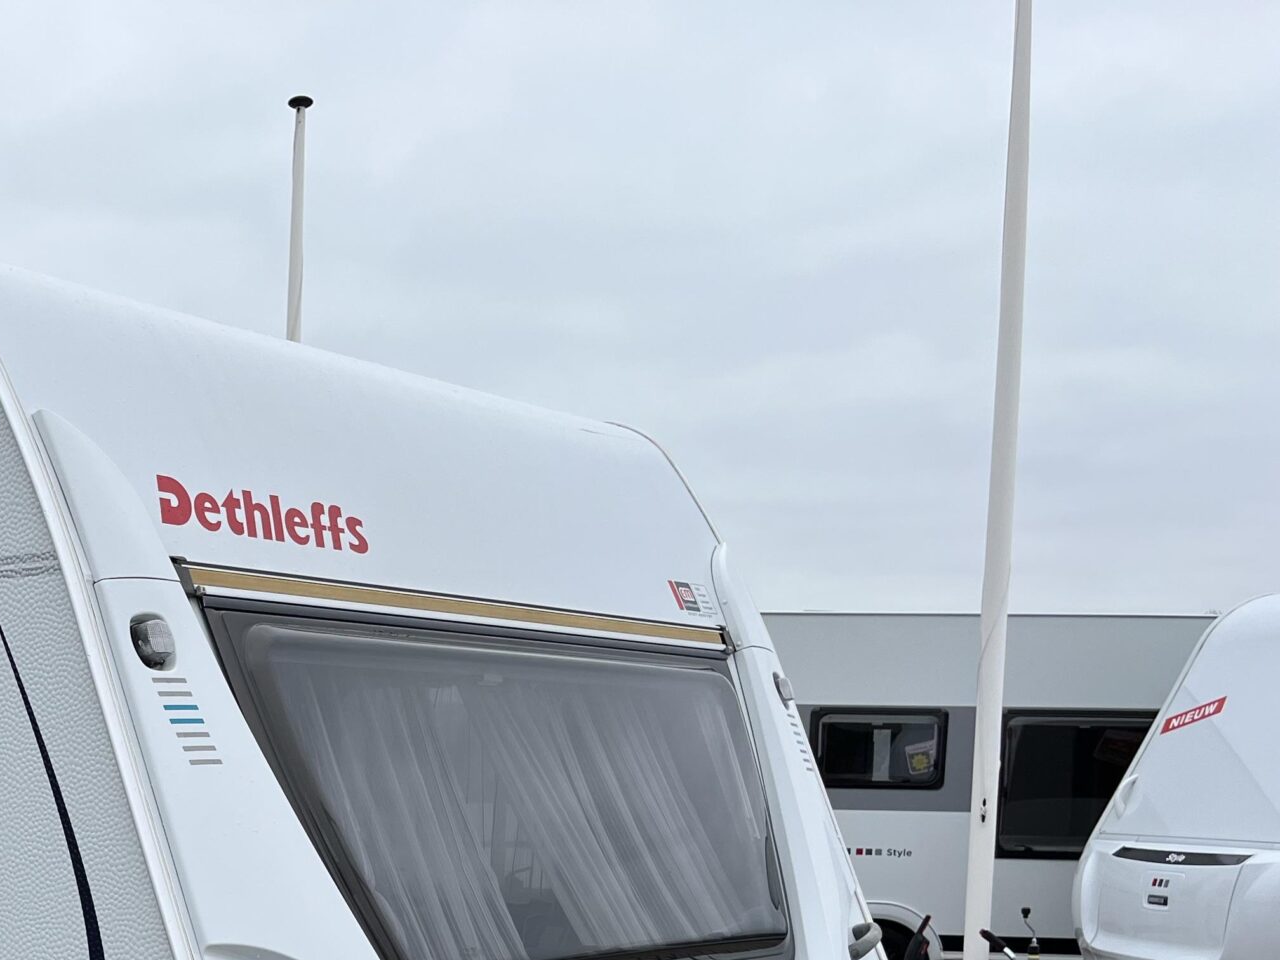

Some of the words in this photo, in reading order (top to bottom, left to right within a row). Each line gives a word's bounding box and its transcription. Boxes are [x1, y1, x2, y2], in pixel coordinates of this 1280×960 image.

[156, 474, 369, 554] Dethleffs
[1168, 701, 1219, 729] NIEUW
[886, 848, 913, 858] Style
